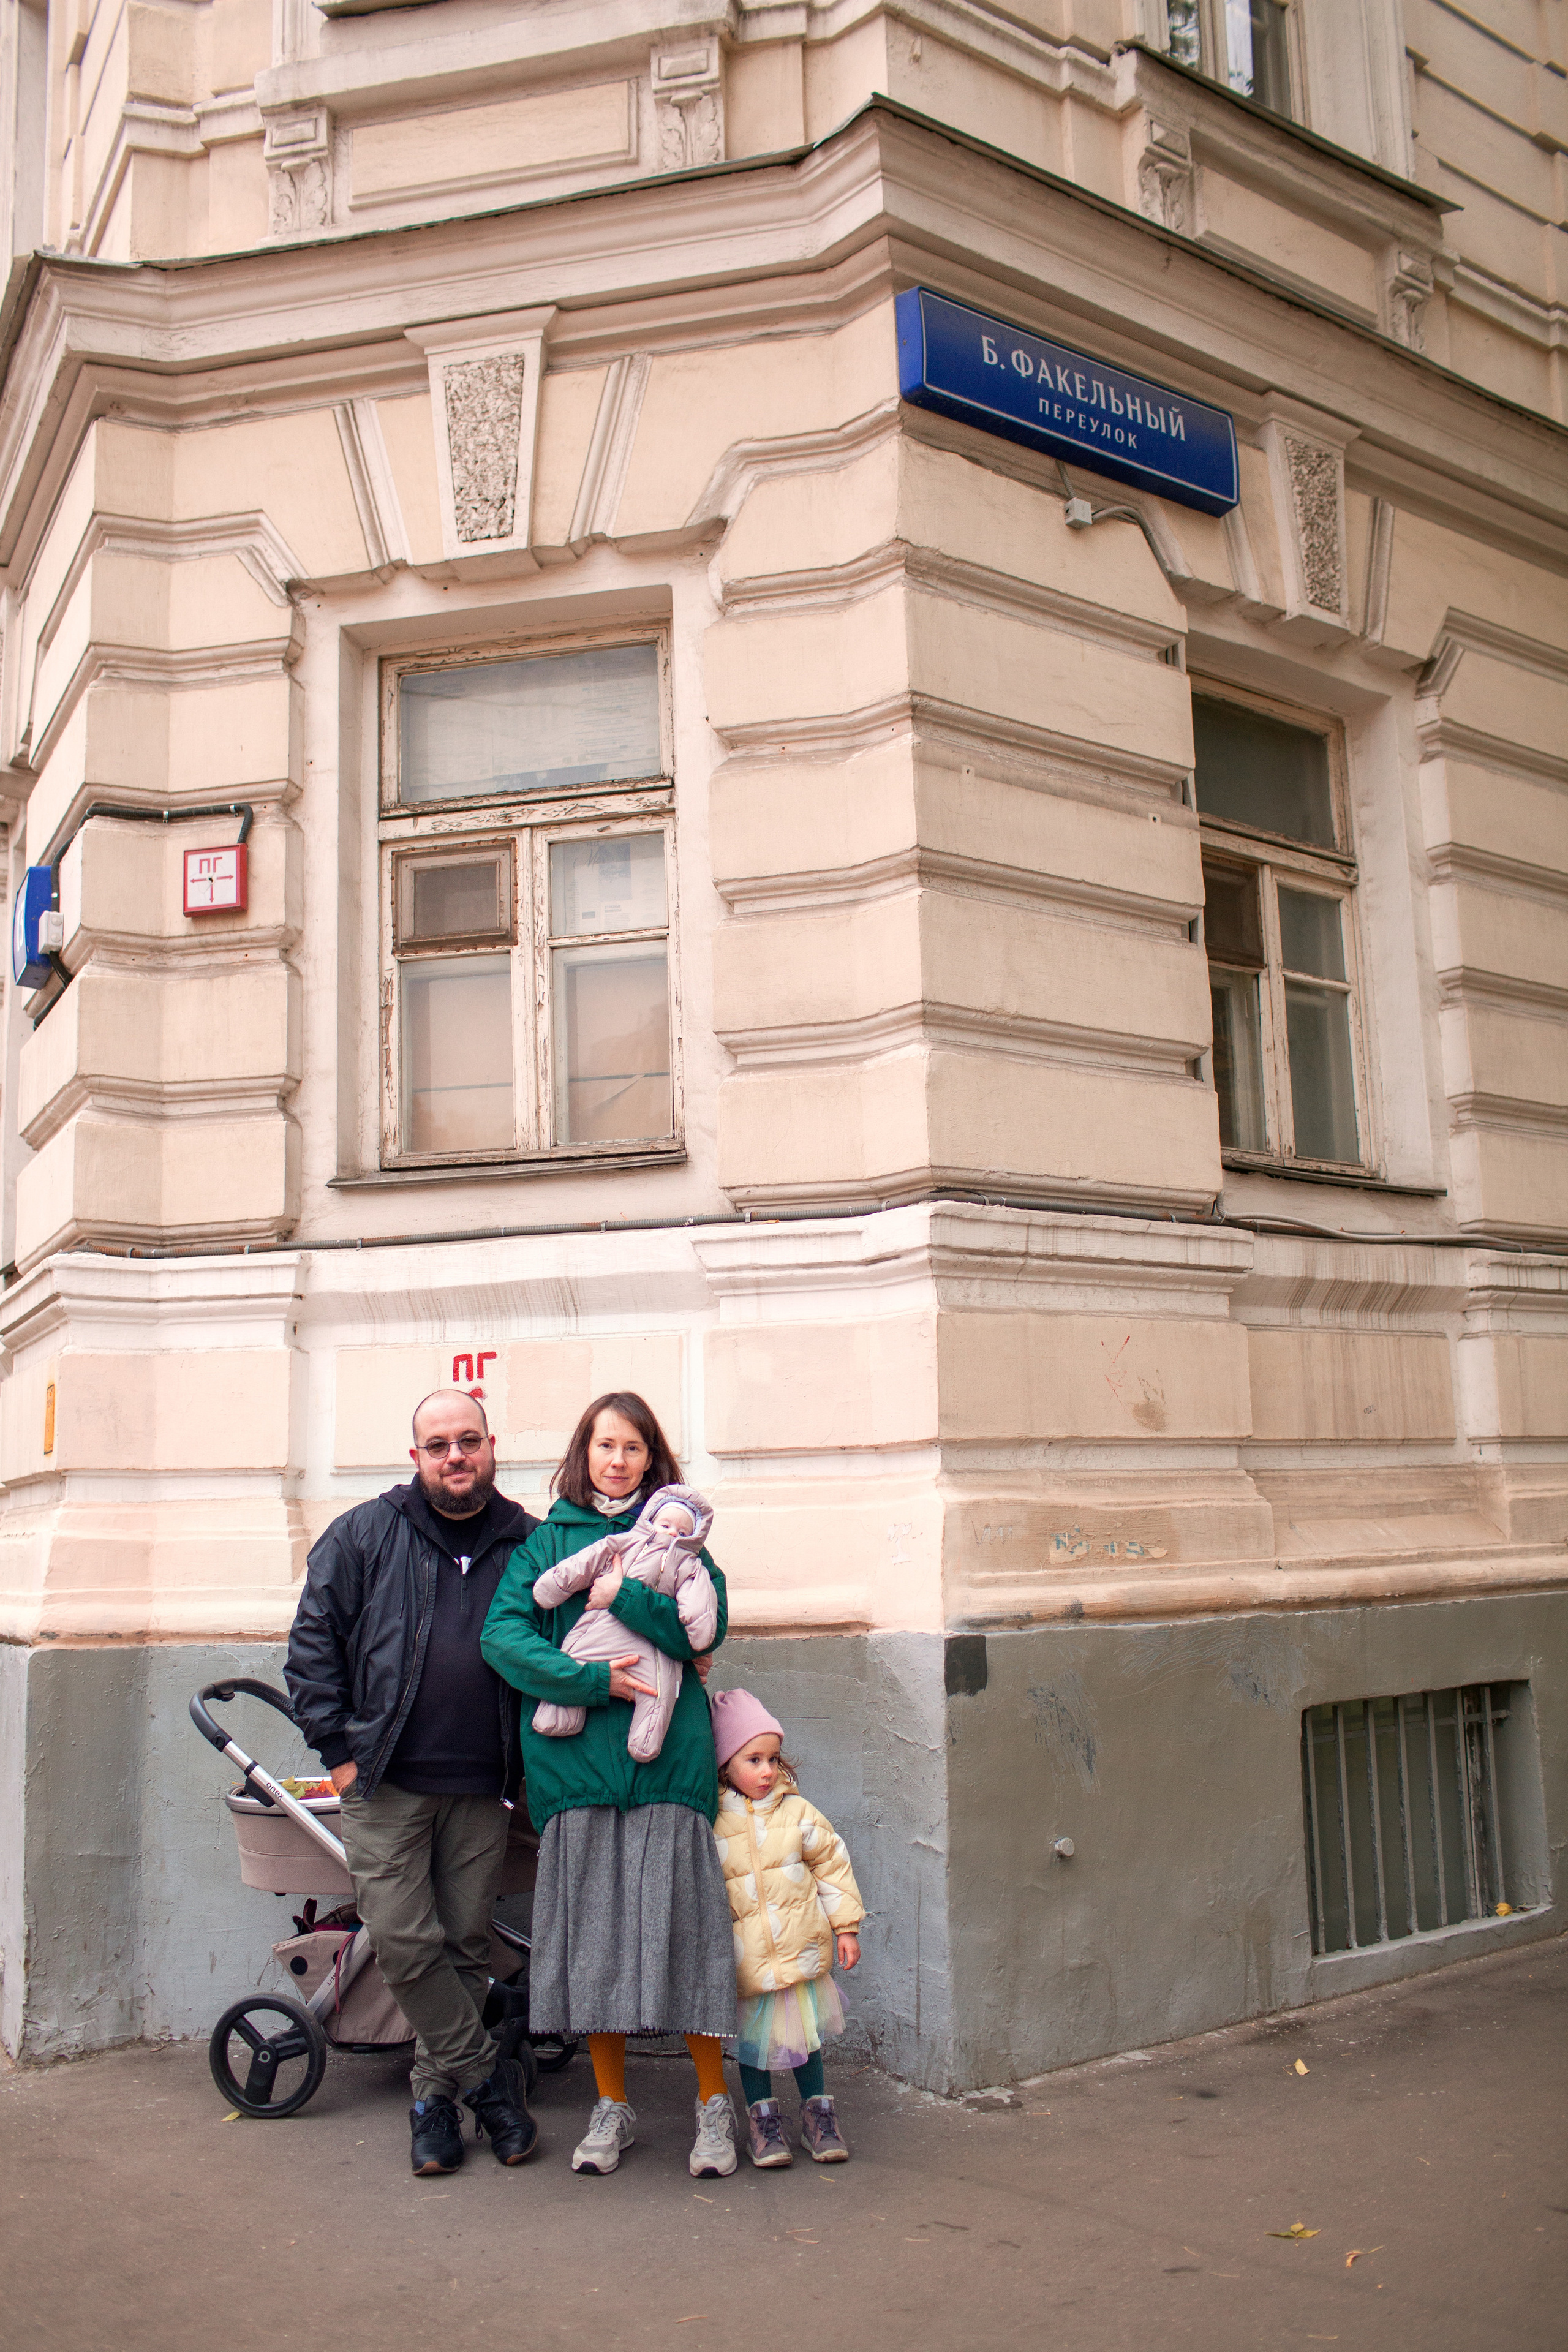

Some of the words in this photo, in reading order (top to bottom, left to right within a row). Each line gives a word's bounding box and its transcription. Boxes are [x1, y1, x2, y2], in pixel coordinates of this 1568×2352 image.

[981, 334, 1006, 370] Б.
[1011, 349, 1186, 442] ФАКЕЛЬНЫЙ
[1039, 398, 1138, 450] ПЕРЕУЛОК
[199, 857, 223, 874] ПГ
[452, 1351, 498, 1382] ПГ
